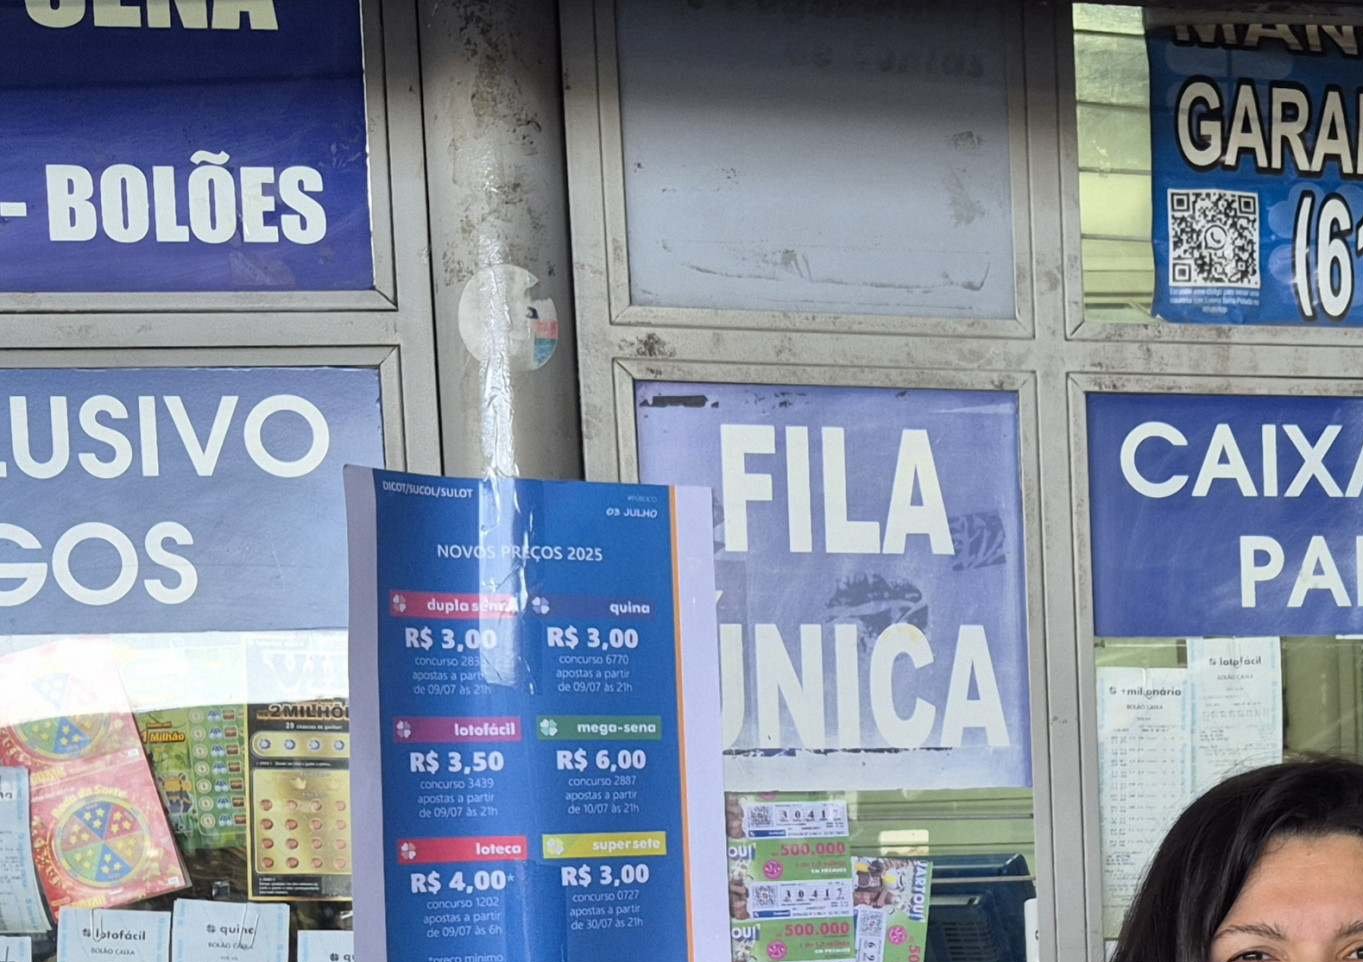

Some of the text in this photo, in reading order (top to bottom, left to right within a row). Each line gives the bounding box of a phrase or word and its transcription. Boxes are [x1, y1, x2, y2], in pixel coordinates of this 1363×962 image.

[46, 149, 328, 244] BOLÕES
[0, 394, 330, 479] USIVO
[720, 424, 955, 556] FILA
[624, 508, 658, 519] JULHO
[437, 544, 603, 562] NOVOS PREÇOS 2025
[0, 522, 198, 606] GOS
[427, 598, 470, 615] dupla
[609, 600, 651, 616] quina
[405, 627, 498, 652] R$ 3,00
[546, 625, 639, 651] R$ 3,00
[414, 656, 459, 666] concurso
[559, 654, 630, 665] concurso 6770
[556, 670, 594, 681] apostas
[604, 670, 631, 680] partir
[557, 682, 572, 692] de
[572, 681, 602, 693] 09/07
[616, 681, 634, 692] 21h
[454, 721, 517, 737] lotofácil
[576, 723, 657, 736] mega-sena
[409, 749, 506, 775] R$ 3,50
[556, 747, 648, 772] R$ 6,00
[420, 777, 495, 790] concurso 3439
[568, 775, 638, 787] concurso 2887
[417, 793, 456, 806] apostas
[466, 791, 496, 804] partir
[565, 792, 603, 803] apostas
[612, 789, 638, 801] partir
[418, 808, 433, 819] de
[433, 807, 463, 819] 09/07
[480, 806, 499, 818] 21h
[567, 804, 582, 815] de
[583, 803, 609, 815] 10/07
[623, 802, 641, 814] 21h
[475, 842, 522, 856] loteca
[410, 870, 442, 895] R$
[561, 864, 650, 888] R$ 3,00
[426, 897, 500, 910] concurso 1202
[572, 890, 640, 903] concurso 0727
[423, 913, 462, 926] apostas
[472, 911, 502, 924] partir
[570, 908, 605, 919] apostas
[614, 904, 641, 916] partir
[426, 927, 441, 938] de
[441, 925, 472, 938] 09/07
[488, 923, 503, 935] 6h
[570, 920, 585, 931] de
[586, 919, 612, 930] 30/07
[626, 917, 643, 928] 21h
[95, 928, 146, 941] lotofácil
